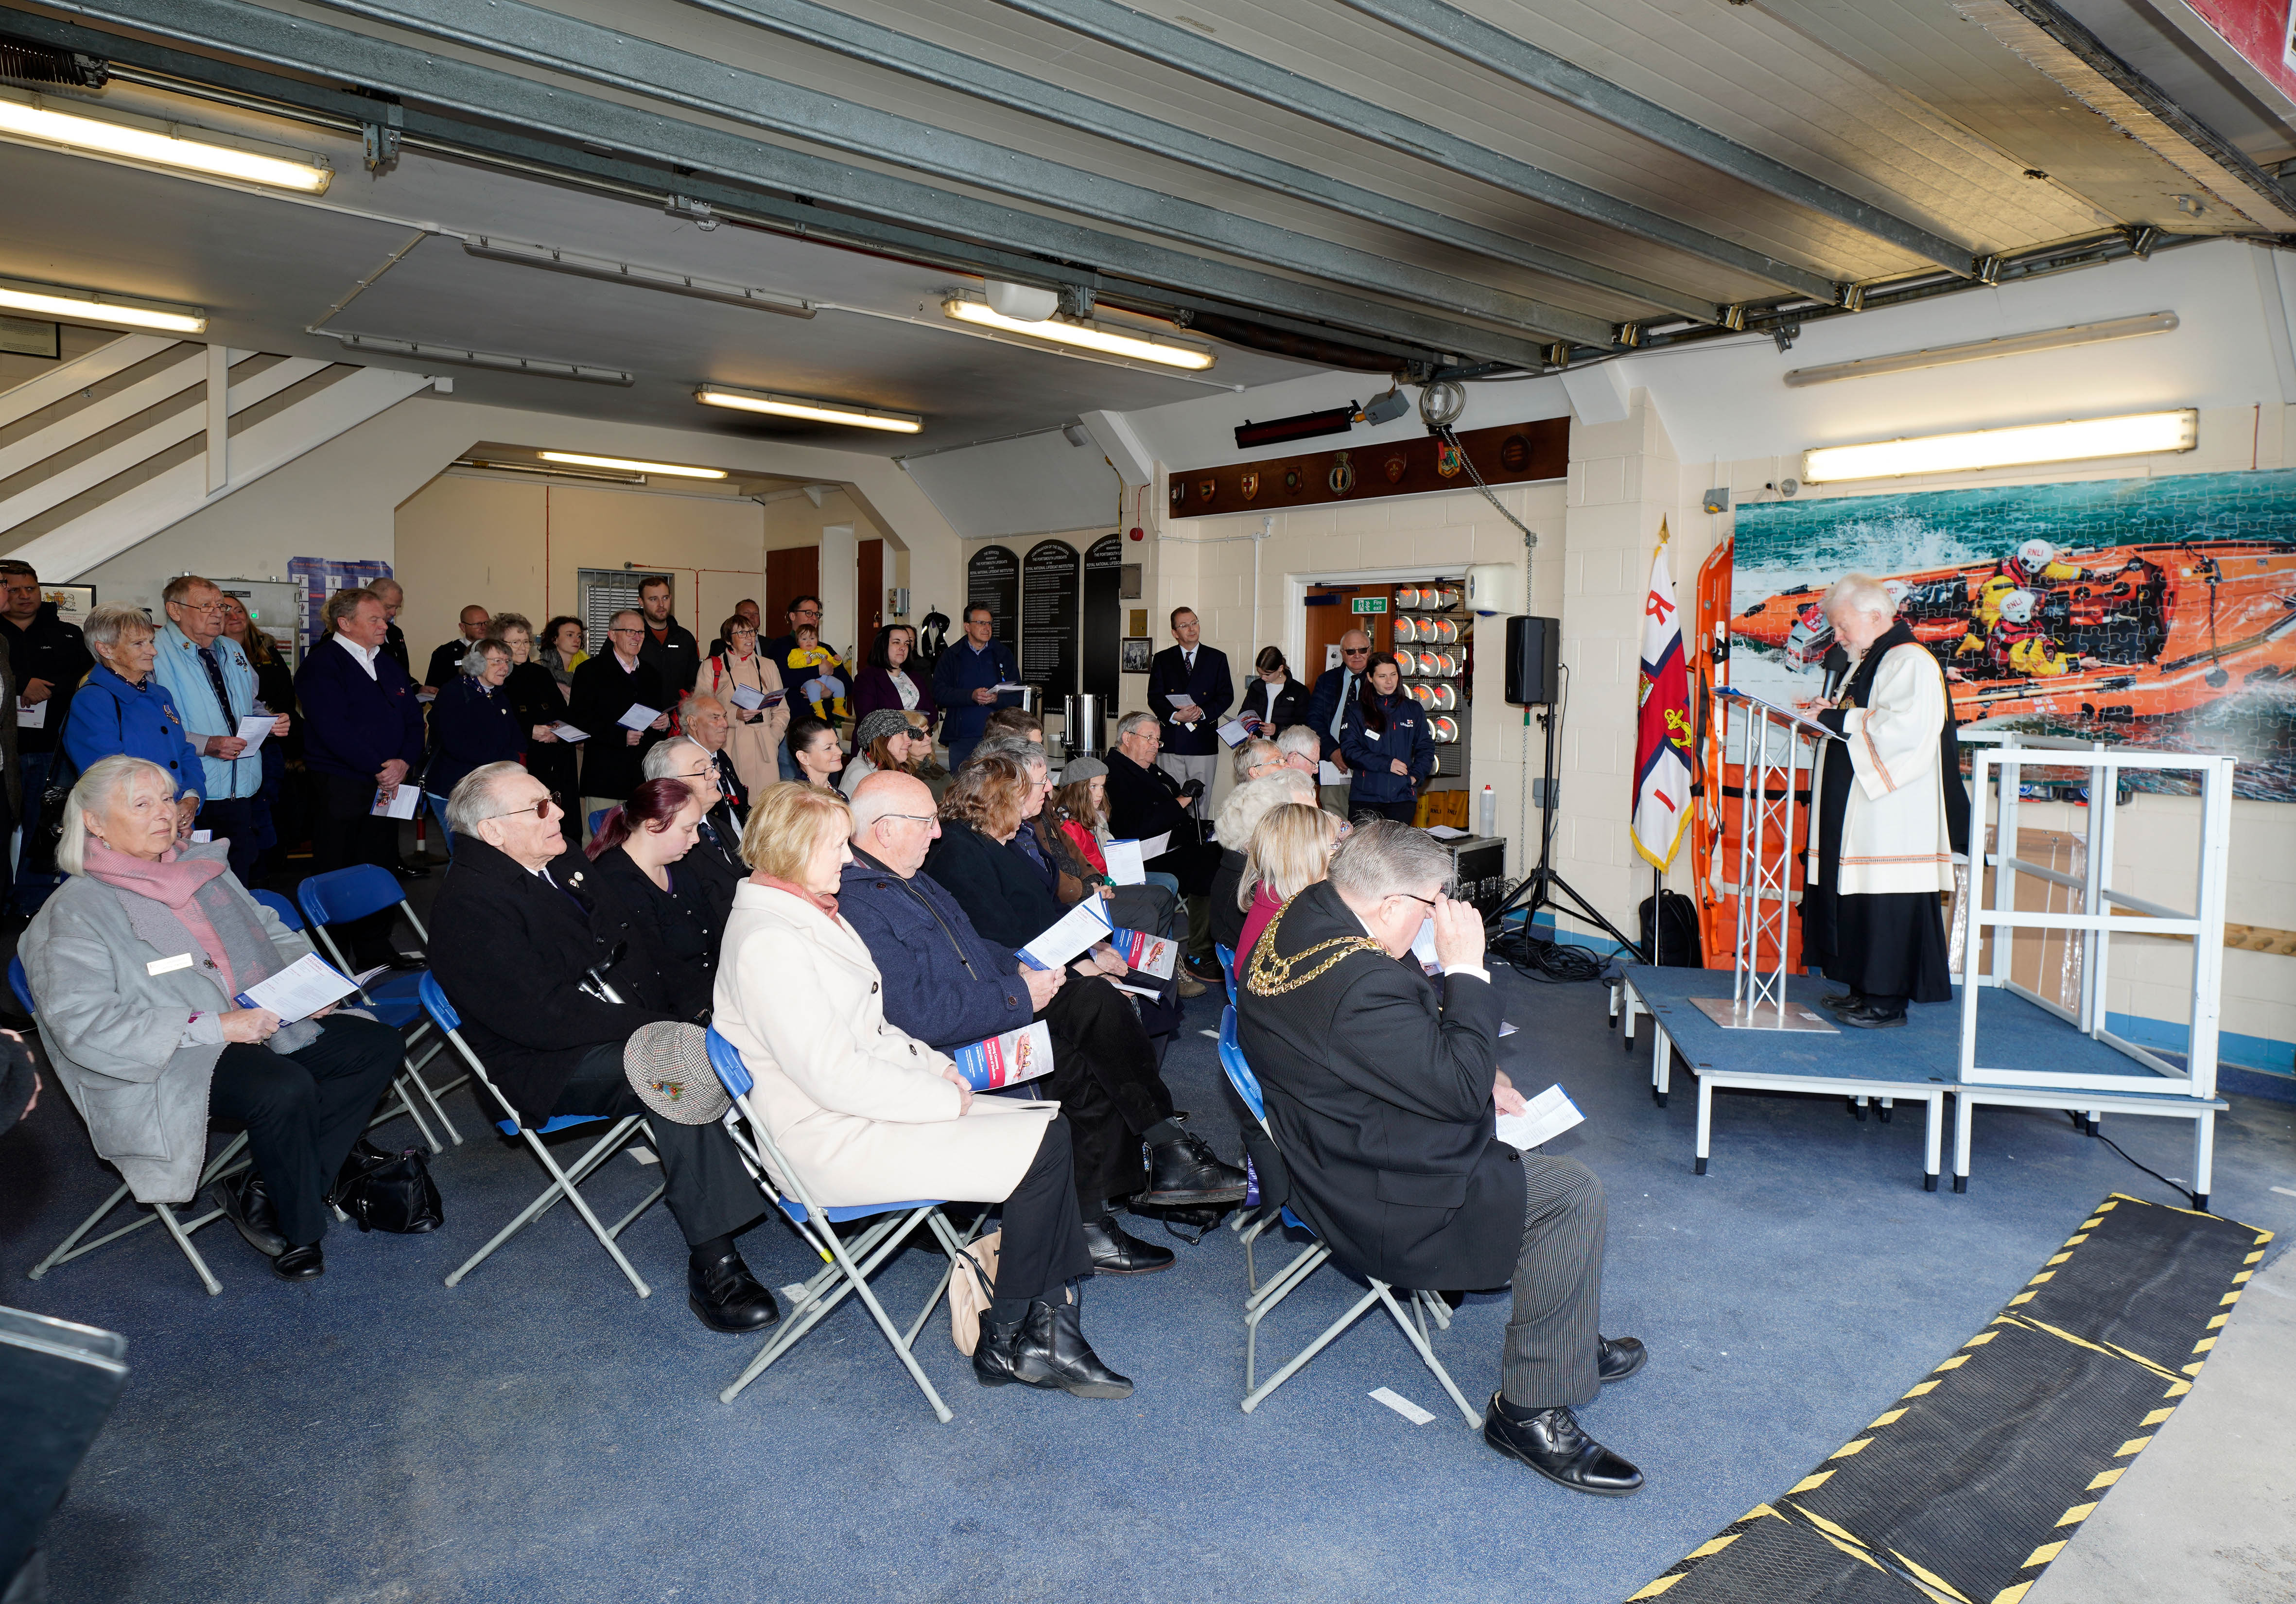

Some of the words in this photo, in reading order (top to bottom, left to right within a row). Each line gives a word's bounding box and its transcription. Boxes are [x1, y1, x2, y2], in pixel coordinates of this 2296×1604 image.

[2027, 548, 2044, 557] RNLI
[1646, 590, 1675, 626] R
[2006, 597, 2022, 611] RNLI
